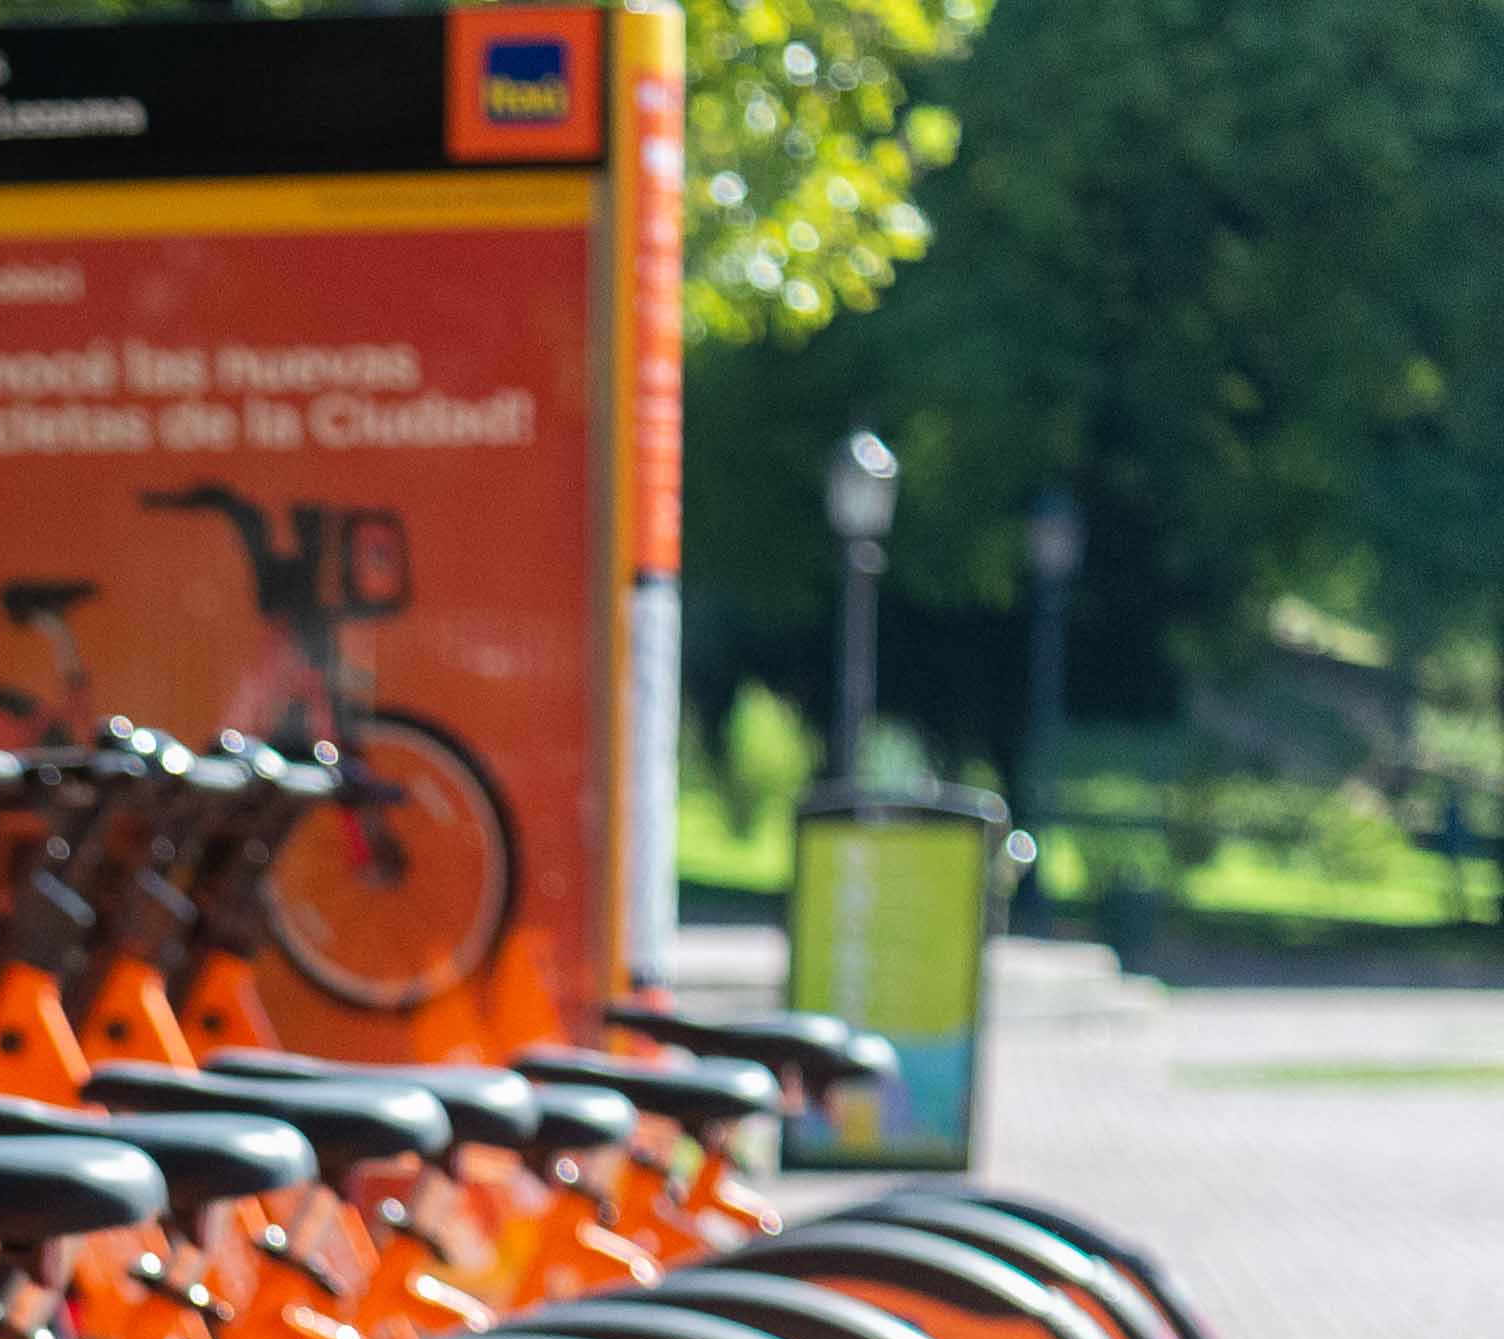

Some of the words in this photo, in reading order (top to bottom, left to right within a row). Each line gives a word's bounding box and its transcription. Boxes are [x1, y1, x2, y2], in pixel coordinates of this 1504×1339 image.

[125, 341, 205, 394] las
[215, 345, 419, 392] nuevas
[160, 401, 235, 451] de
[244, 399, 302, 450] la
